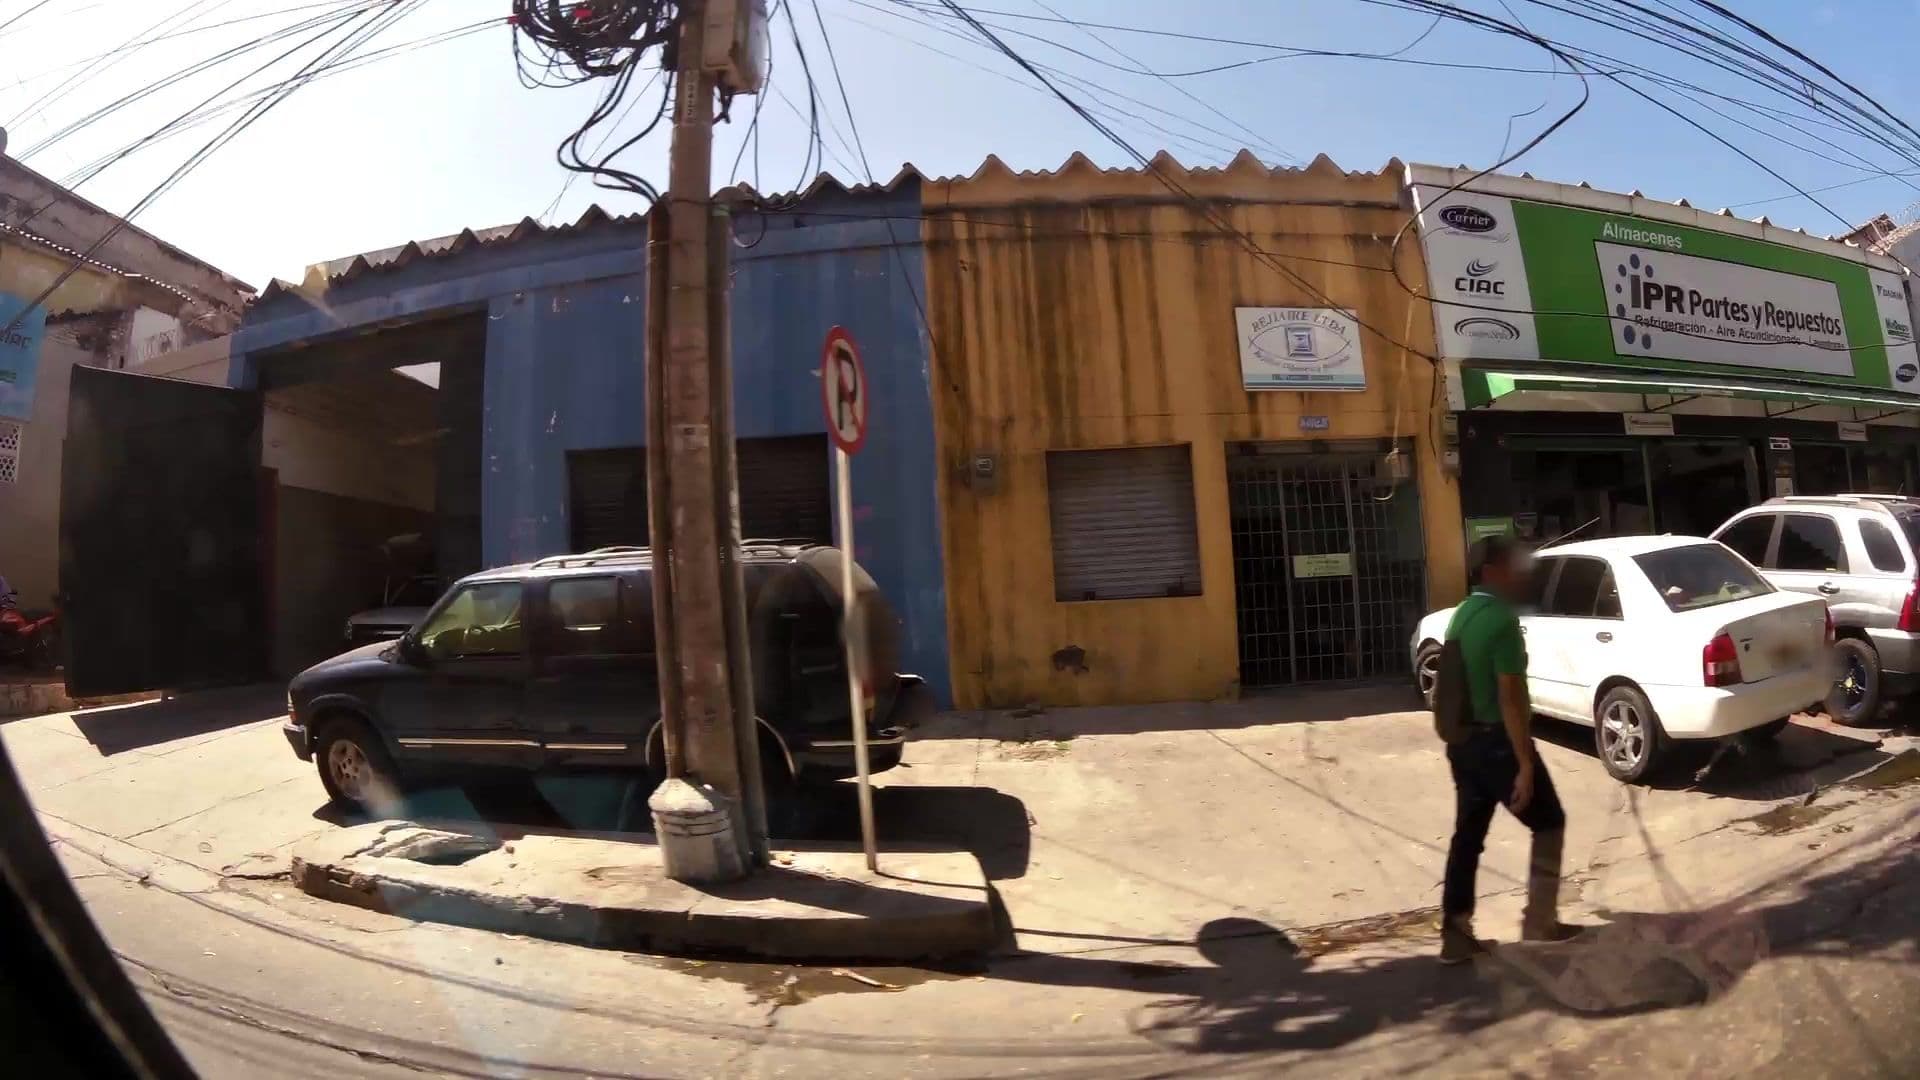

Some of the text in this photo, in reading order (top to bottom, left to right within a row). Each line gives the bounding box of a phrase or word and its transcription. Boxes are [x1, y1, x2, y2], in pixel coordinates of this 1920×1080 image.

[1446, 207, 1491, 227] Carrier
[1603, 222, 1683, 249] Almacenes
[1454, 277, 1505, 295] CIAC
[1689, 289, 1750, 322] Partes
[1752, 305, 1762, 330] y
[1764, 301, 1842, 336] Repuestos
